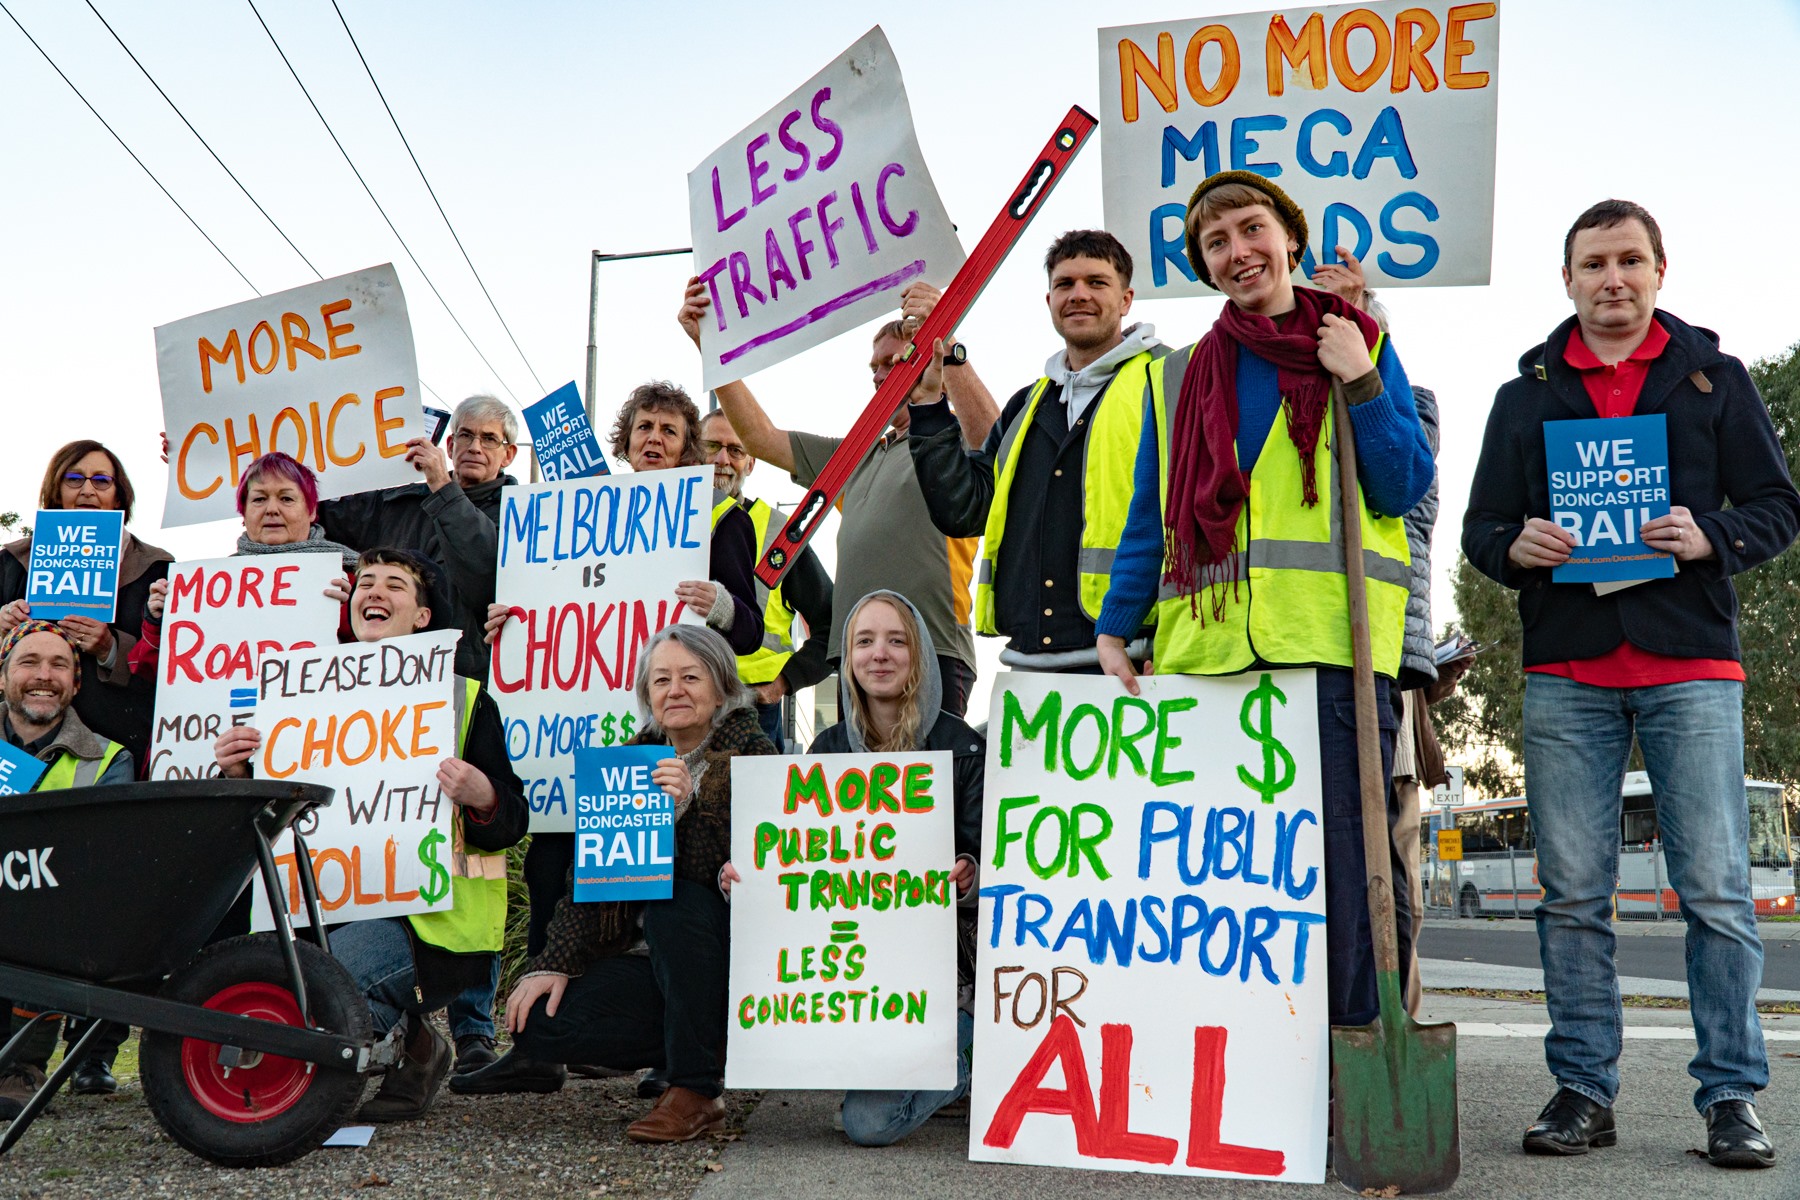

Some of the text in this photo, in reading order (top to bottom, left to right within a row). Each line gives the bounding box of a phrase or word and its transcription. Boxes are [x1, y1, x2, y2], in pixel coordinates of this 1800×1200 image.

[1118, 2, 1497, 123] NO MORE
[712, 87, 844, 232] LESS
[1161, 106, 1418, 188] MEGA
[699, 163, 919, 332] TRAFFIC
[1150, 191, 1440, 287] RDS
[198, 298, 362, 393] MORE
[535, 413, 586, 452] SUPPORT
[541, 402, 569, 430] WE
[177, 386, 409, 500] CHOICE
[539, 428, 592, 463] DONCASTER
[542, 443, 604, 482] RAIL
[1576, 439, 1635, 468] WE
[1551, 466, 1667, 490] SUPPORT
[1553, 488, 1667, 507] DONCASTER
[57, 525, 97, 543] WE
[501, 477, 703, 567] MELBOURNE
[34, 559, 114, 569] DONCASTER
[35, 544, 116, 557] SUPPORT
[31, 571, 113, 597] RAIL
[170, 566, 300, 614] MORE
[583, 563, 606, 588] IS
[493, 600, 689, 693] CHOKIN
[261, 645, 453, 700] PLEASE DON'T
[264, 701, 447, 778] CHOKE
[535, 713, 598, 758] MORE
[1000, 672, 1296, 804] MORE $
[601, 765, 649, 791] WE
[783, 762, 935, 817] MORE
[1437, 793, 1461, 802] EXIT
[346, 780, 442, 825] WITH
[578, 793, 671, 812] SUPPORT
[578, 813, 671, 829] DONCASTER
[577, 830, 672, 868] RAIL
[993, 794, 1319, 899] FOR PUBLIC
[778, 869, 952, 912] TRANSPORT
[979, 884, 1326, 986] TRANSPORT
[777, 944, 866, 983] LESS
[993, 965, 1088, 1030] FOR
[983, 1014, 1286, 1176] ALL
